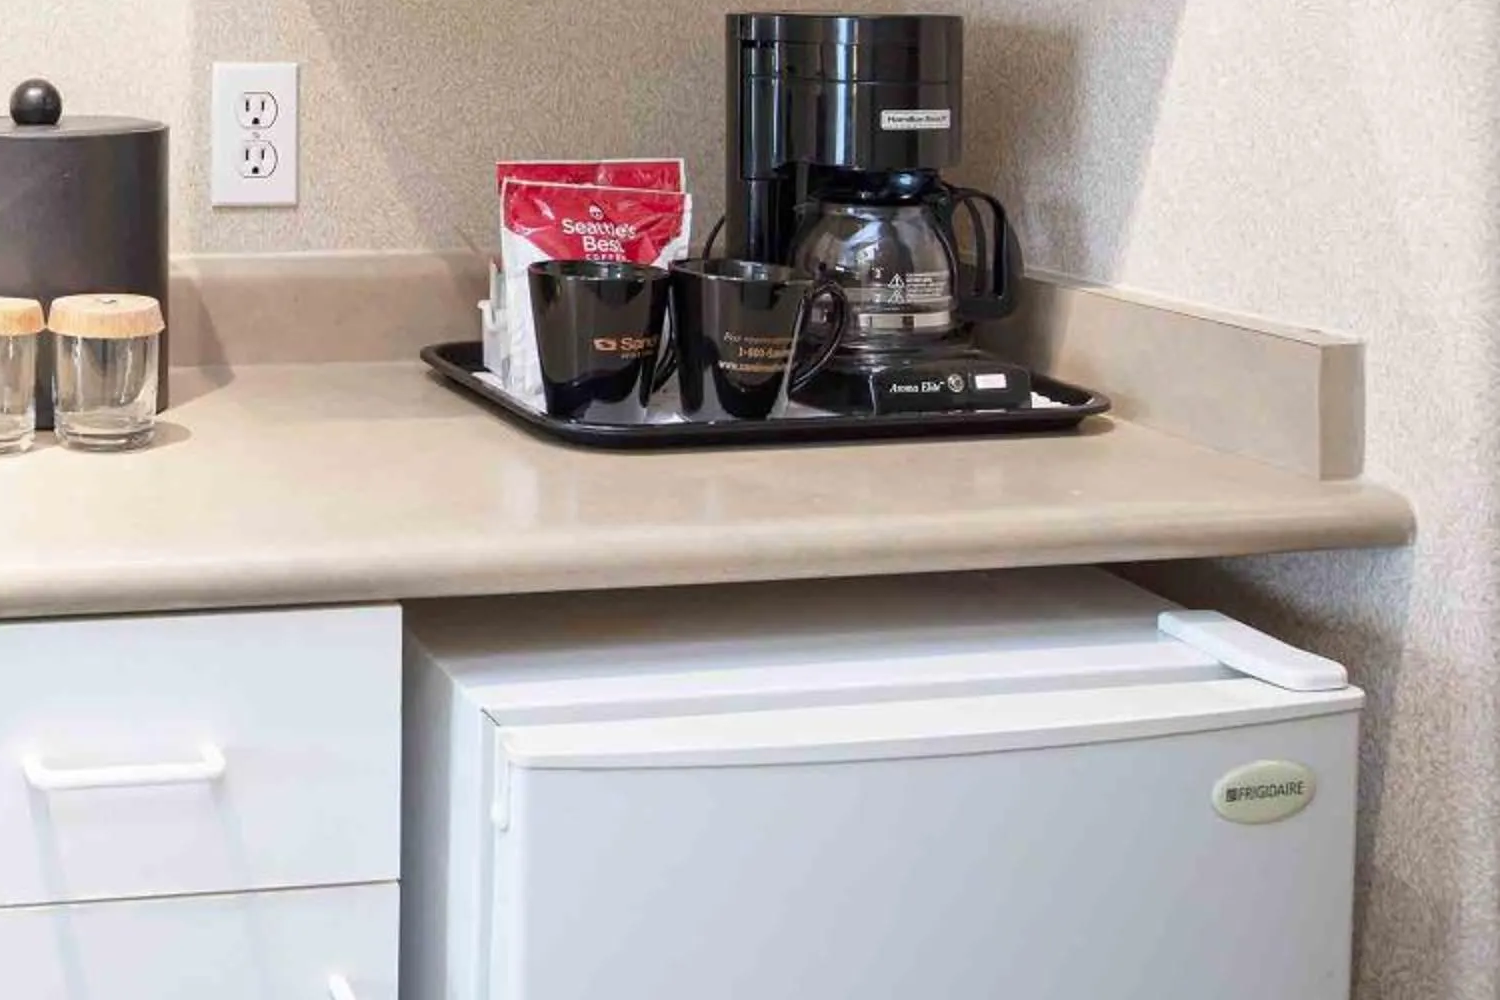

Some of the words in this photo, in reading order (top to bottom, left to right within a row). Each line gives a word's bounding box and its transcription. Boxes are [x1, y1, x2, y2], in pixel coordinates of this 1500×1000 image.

[583, 235, 625, 253] Best
[889, 383, 919, 393] Aroma
[1238, 780, 1305, 801] FRIGIDAIRE
